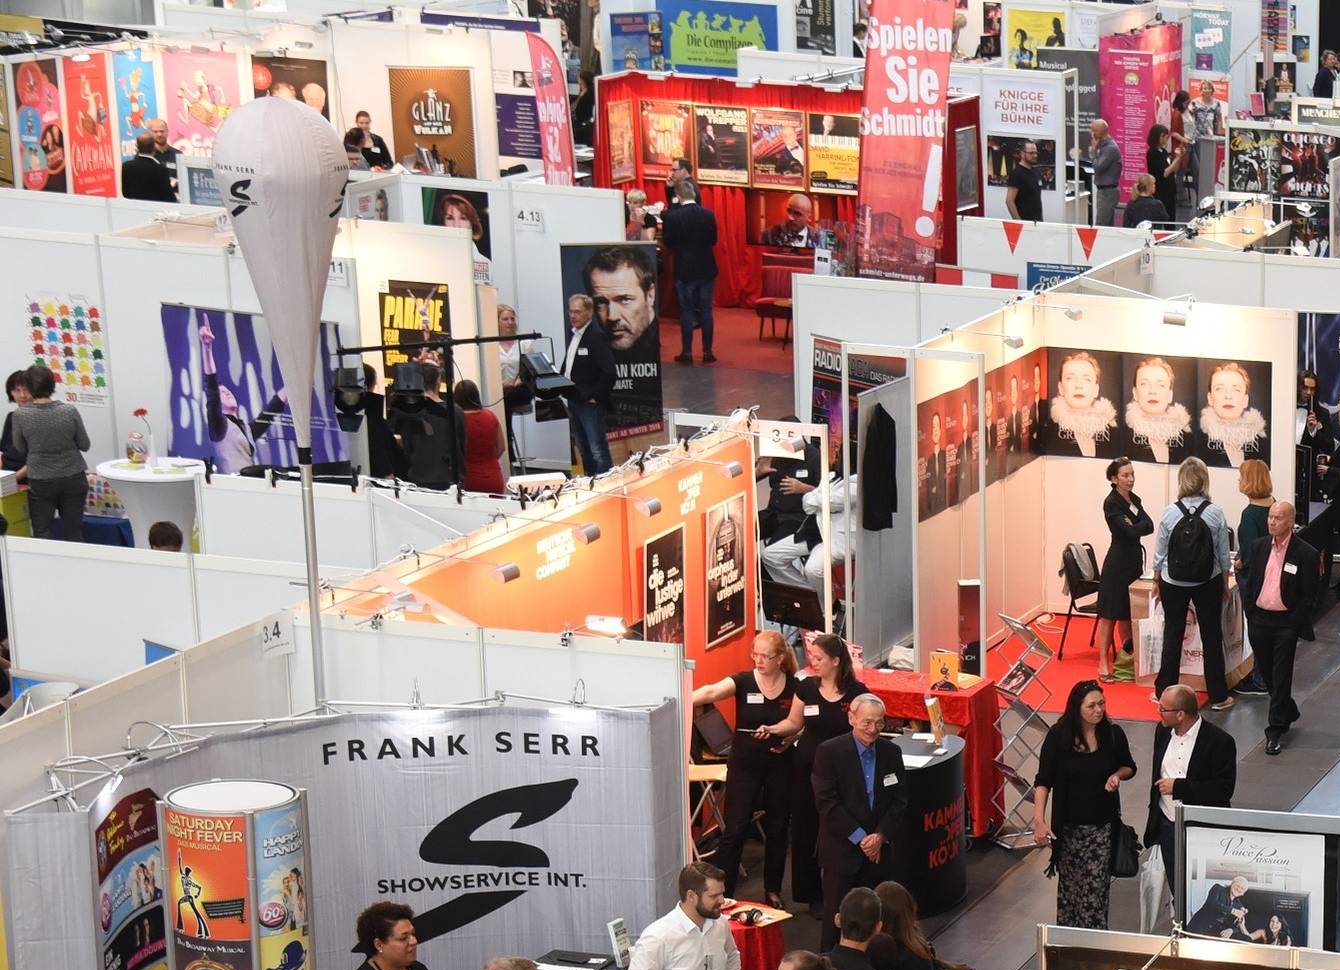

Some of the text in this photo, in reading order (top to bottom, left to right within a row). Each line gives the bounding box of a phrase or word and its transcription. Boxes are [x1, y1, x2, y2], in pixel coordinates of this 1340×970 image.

[687, 33, 700, 46] Die
[867, 17, 952, 56] Spielen
[1040, 61, 1067, 70] Musical
[885, 56, 940, 104] Sie
[1000, 89, 1044, 101] KNIGGE
[412, 98, 451, 122] GLANZ
[696, 107, 747, 119] WOLFGANG
[994, 100, 1049, 114] FÜR IHRE
[708, 117, 748, 127] TREPPER
[860, 107, 944, 137] Schmidt
[1001, 112, 1044, 125] BÜHNE
[413, 124, 452, 135] VULKAN
[1283, 133, 1336, 146] CHICAGO
[72, 143, 114, 175] CAVEMAN
[517, 210, 541, 223] 4.13
[383, 297, 443, 332] PARADE
[631, 363, 657, 377] KOCH
[814, 350, 842, 371] RADIO
[869, 372, 882, 382] DAS
[649, 568, 664, 590] die
[708, 559, 734, 580] orpheus
[655, 579, 683, 606] lustige
[717, 576, 745, 602] unterwelt
[647, 600, 675, 628] witwe
[263, 621, 281, 644] 3.4
[322, 731, 600, 765] FRANK SERR
[169, 812, 234, 831] SATURDAY
[167, 824, 243, 843] NIGHT FEVER
[190, 843, 222, 851] MUSICAL
[1220, 836, 1291, 866] Voice Passion
[377, 871, 587, 894] SHOWSERVICE INT.
[216, 945, 245, 954] MUSICAL
